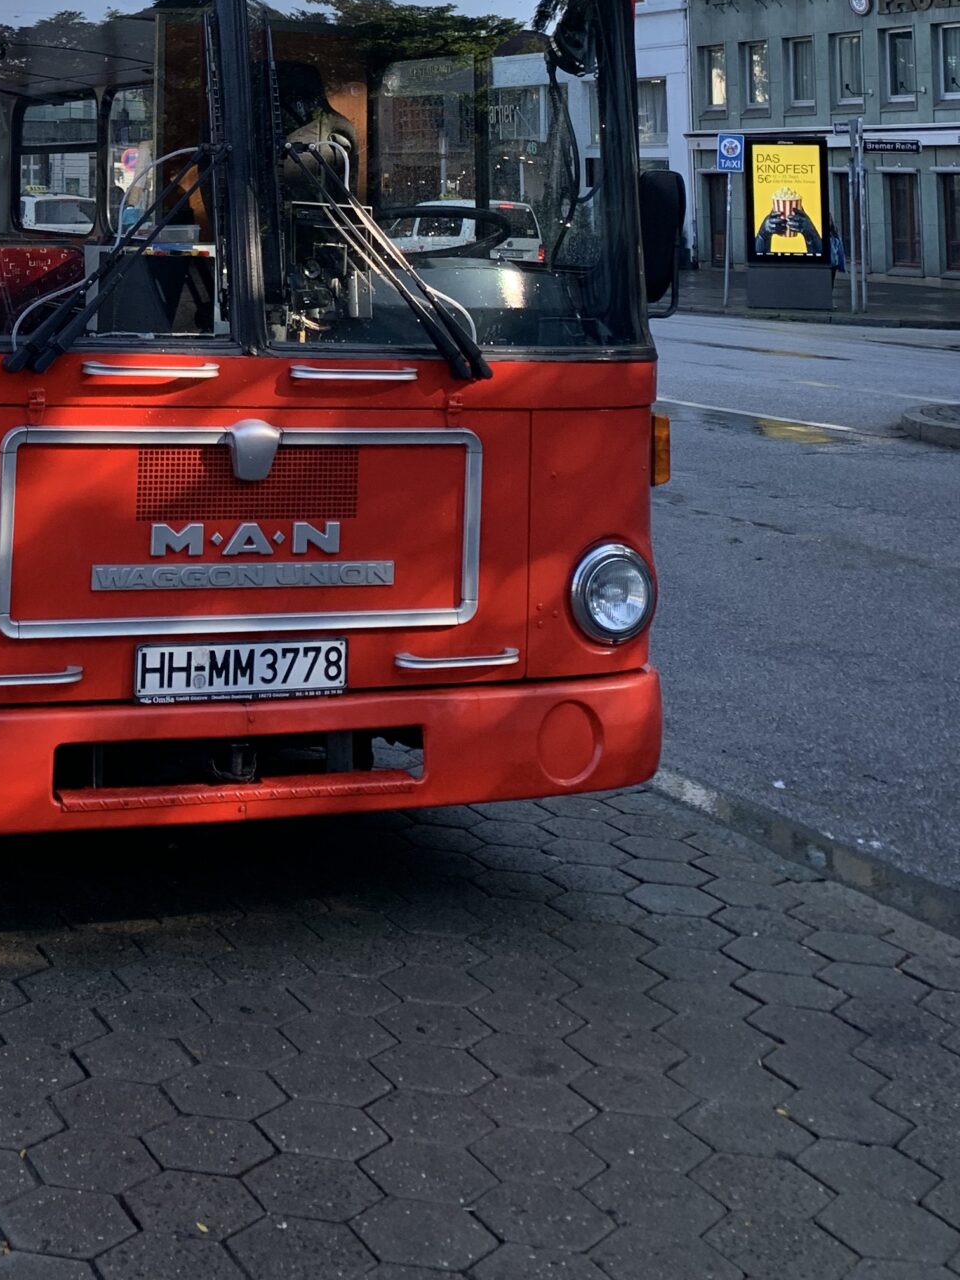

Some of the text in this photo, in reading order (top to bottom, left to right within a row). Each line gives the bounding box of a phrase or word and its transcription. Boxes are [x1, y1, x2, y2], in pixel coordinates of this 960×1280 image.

[866, 142, 894, 150] Bremer
[720, 159, 741, 168] TAXI
[756, 153, 780, 164] DAS
[756, 164, 816, 174] KINOFEST
[757, 174, 772, 184] 5€
[94, 562, 394, 590] WAGGON UNION
